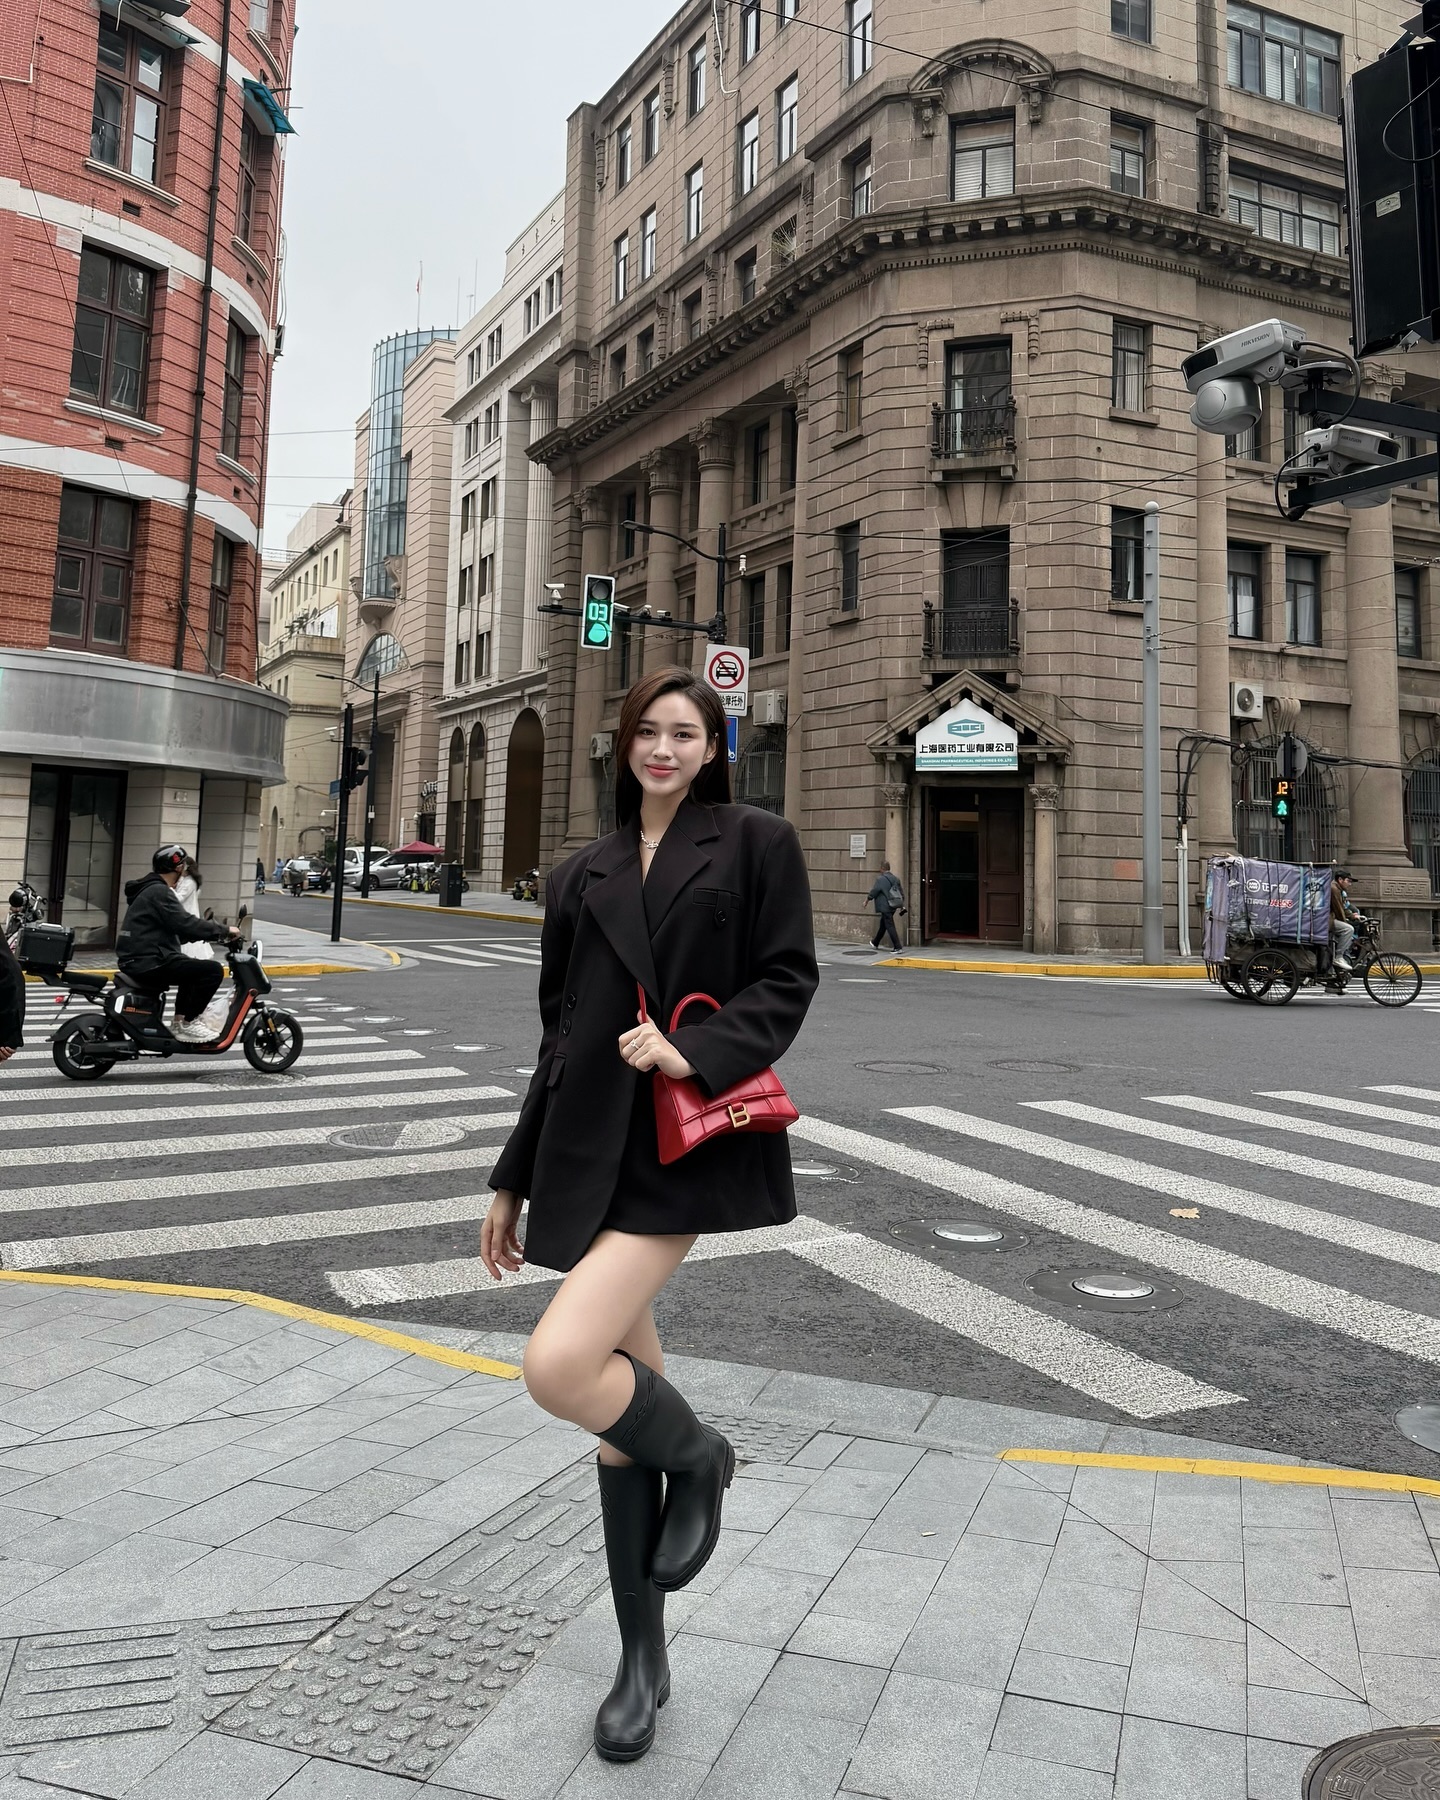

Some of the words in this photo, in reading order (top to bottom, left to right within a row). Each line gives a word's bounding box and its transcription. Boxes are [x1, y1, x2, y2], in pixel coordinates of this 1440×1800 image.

[1241, 332, 1271, 347] HIKVISION
[588, 602, 608, 621] 03
[919, 743, 1014, 753] 上海医药工业有限公司
[728, 1102, 750, 1128] B
